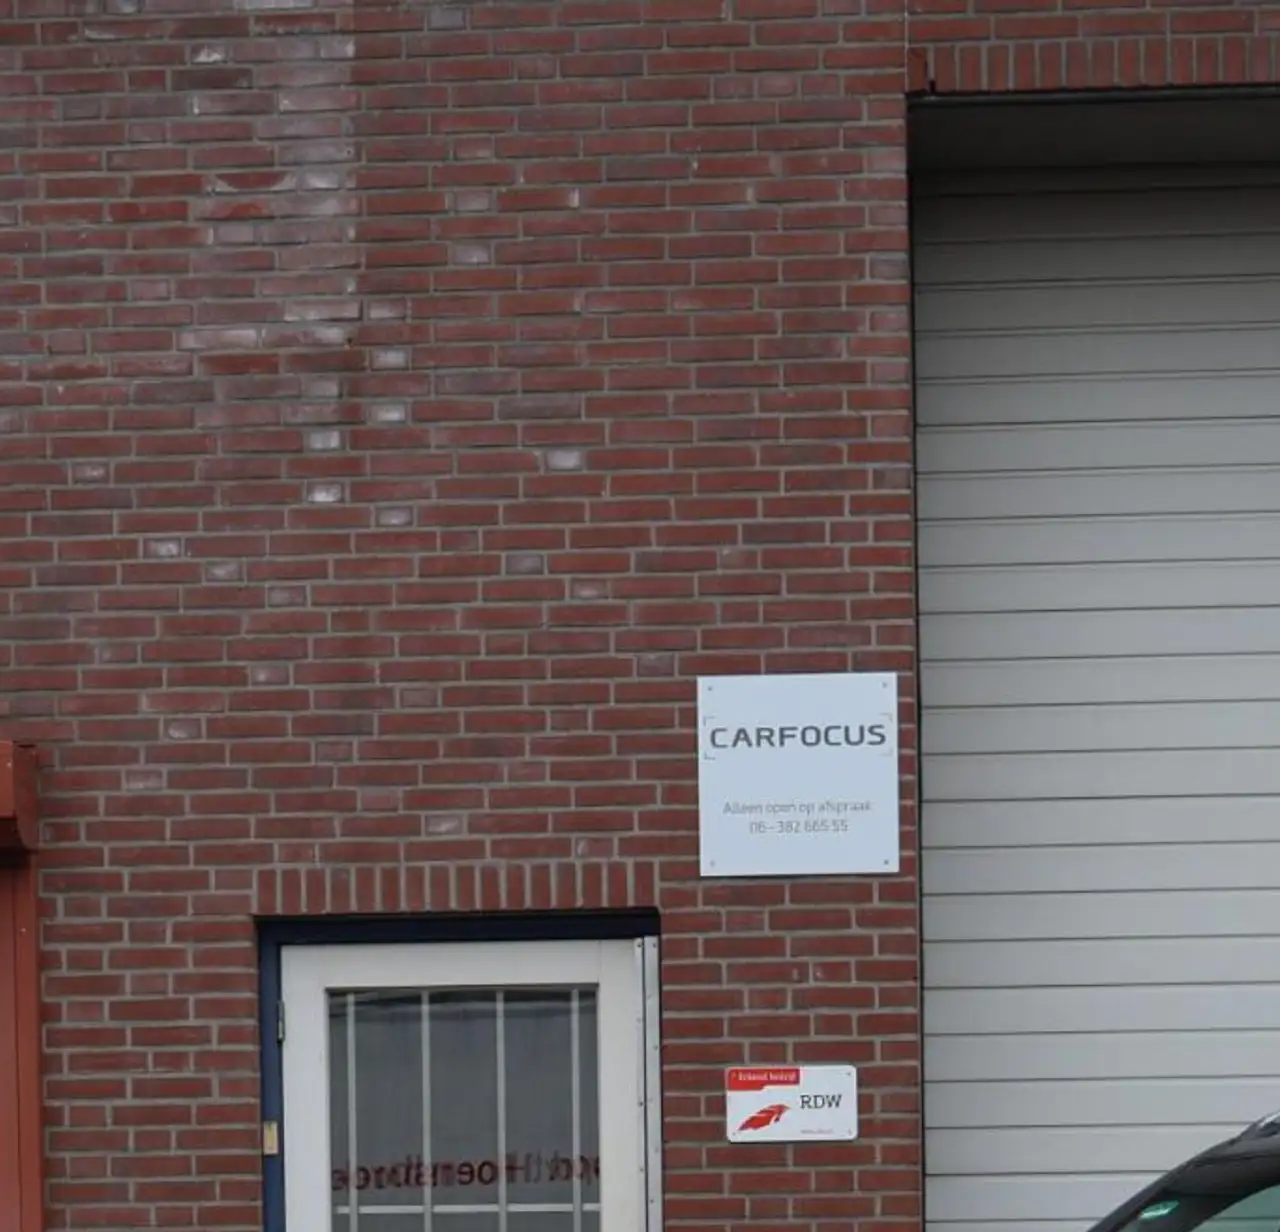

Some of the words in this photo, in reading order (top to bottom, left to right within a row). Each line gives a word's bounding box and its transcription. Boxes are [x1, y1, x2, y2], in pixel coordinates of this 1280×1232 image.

[710, 724, 887, 748] CARFOCUS
[765, 803, 797, 815] open
[800, 1094, 842, 1109] RDW
